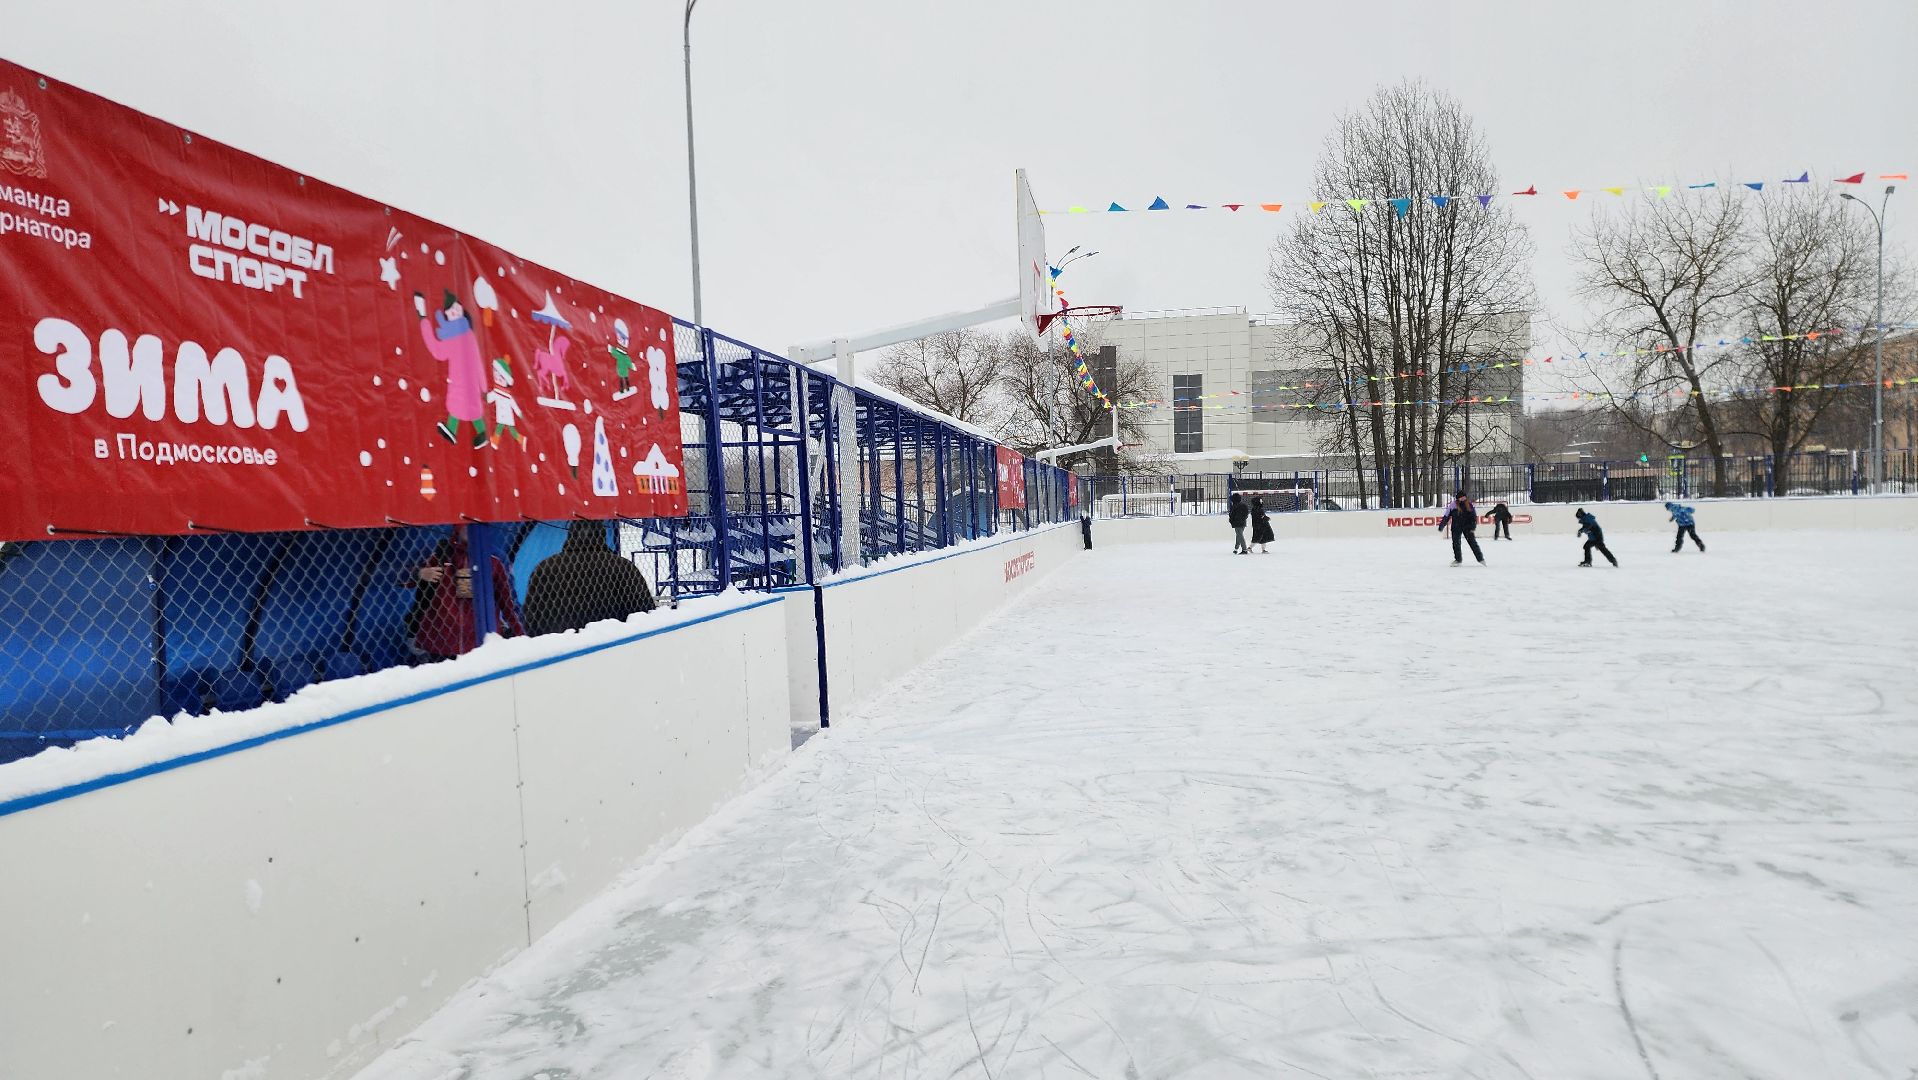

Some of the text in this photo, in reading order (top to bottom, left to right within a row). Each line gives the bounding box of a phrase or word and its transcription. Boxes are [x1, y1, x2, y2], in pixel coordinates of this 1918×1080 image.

[186, 206, 334, 274] МОСОБЛ
[189, 244, 307, 299] СПОРТ
[34, 317, 309, 432] ЗИМА
[95, 433, 278, 466] в Подмосковье
